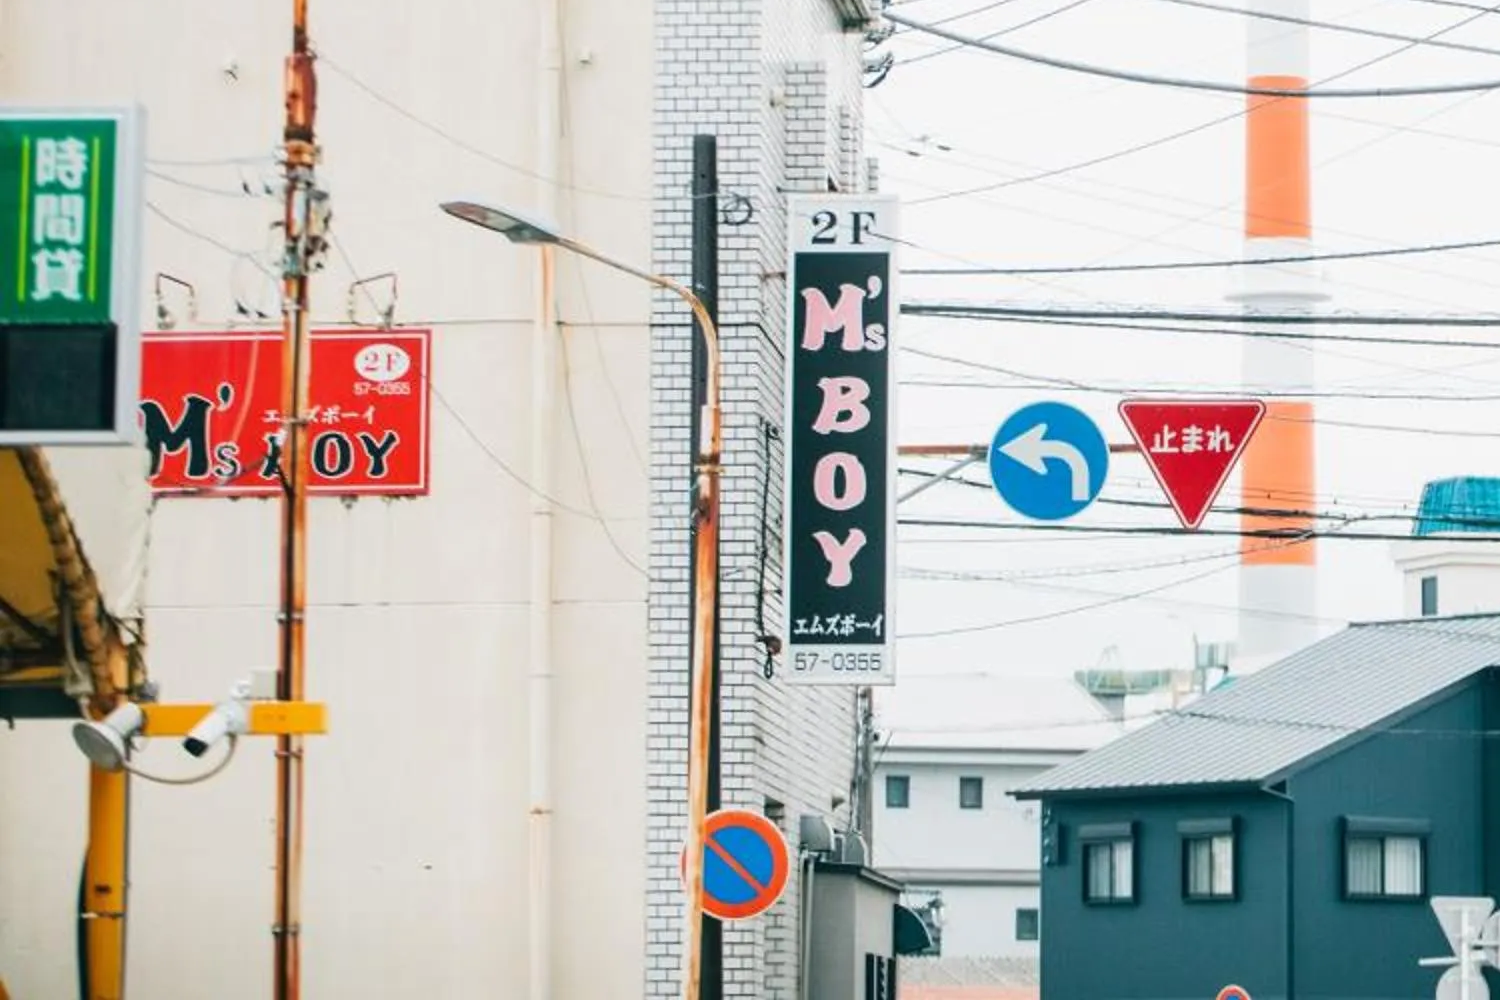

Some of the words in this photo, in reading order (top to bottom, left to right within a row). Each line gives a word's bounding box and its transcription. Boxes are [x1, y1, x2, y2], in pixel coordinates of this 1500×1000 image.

[32, 136, 87, 301] 時間貸
[811, 211, 877, 245] 2F
[364, 350, 402, 372] 2F
[262, 404, 376, 425] エズボーイ
[1150, 424, 1235, 454] 止まれ
[793, 613, 883, 637] エムズボーイ
[795, 652, 882, 671] 57-0355
